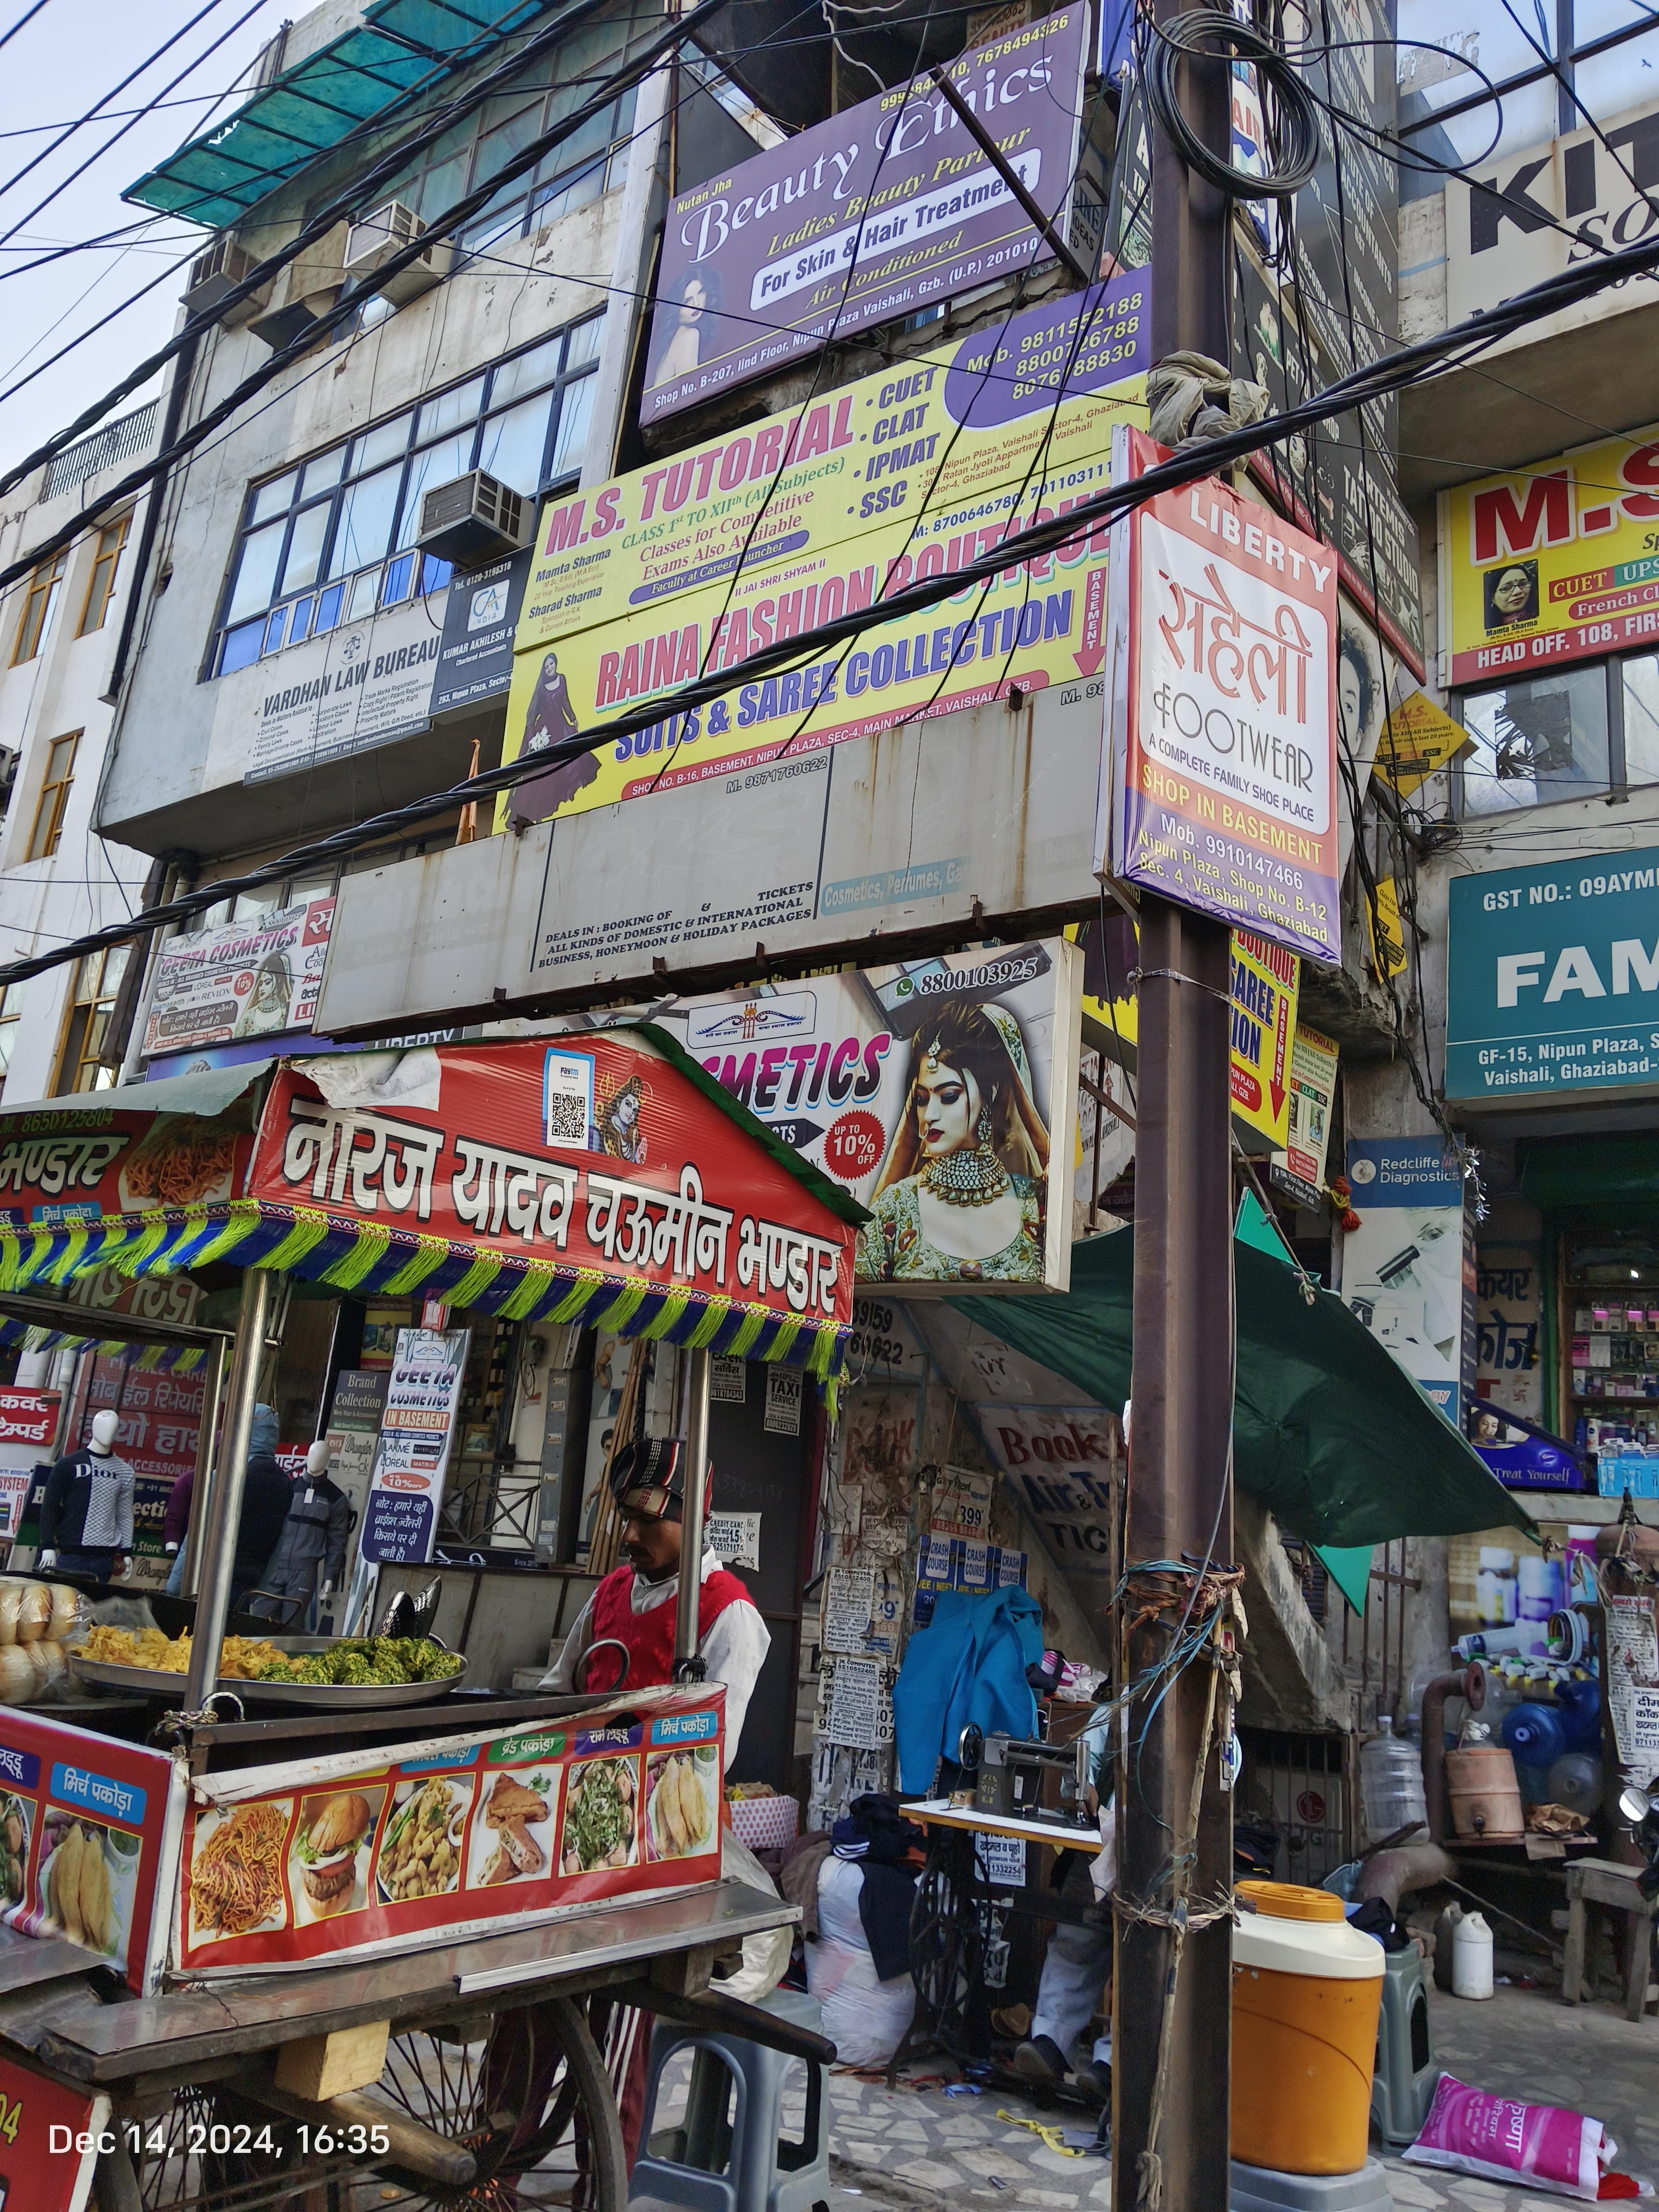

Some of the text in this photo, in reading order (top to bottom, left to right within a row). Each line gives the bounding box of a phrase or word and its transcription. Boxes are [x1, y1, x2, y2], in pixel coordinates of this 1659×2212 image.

[680, 55, 1053, 263] Beauty Ethics
[676, 179, 732, 214] Nutan Jha
[766, 171, 926, 257] Ladies Beauty
[1341, 163, 1393, 294] ACCOUNTANTS
[760, 218, 907, 298] For Skin Hair
[805, 230, 963, 309] Air Conditioned
[1299, 238, 1326, 302] Become
[655, 237, 1038, 408] Shop B-207, Floor, Vaishali, Gzb. 201010
[879, 366, 938, 409] CUET
[873, 403, 930, 445] CLAT
[1055, 421, 1093, 441] Vaishali
[1002, 429, 1039, 449] Vaishali
[866, 433, 940, 481] IPMAT
[544, 395, 855, 556] M.S. TUTORIAL
[860, 481, 907, 518] SSC
[1358, 461, 1406, 547] ARTEMIS
[621, 524, 664, 550] CLASS
[639, 536, 692, 563] Classes
[1190, 490, 1332, 594] LIBERTY
[535, 548, 612, 583] Mamta Sharma
[641, 543, 725, 581] Exams Also
[783, 563, 816, 583] SHYAM
[1384, 527, 1419, 600] STUDIO
[455, 581, 465, 591] Tel.
[650, 558, 734, 596] Faculty Career
[1553, 572, 1607, 598] CUET
[529, 585, 603, 620] Sharad Sharma
[1578, 592, 1638, 617] French
[473, 613, 496, 626] INDIA
[1486, 620, 1538, 637] Mamta Sharma
[443, 630, 505, 661] KUMAR AKHILESH
[595, 565, 876, 709] RAINA FASHION
[1158, 563, 1313, 725] सहेली
[1478, 642, 1526, 669] HEAD
[1532, 633, 1569, 656] OFF.
[1577, 623, 1619, 646] 108,
[456, 644, 507, 667] Chartered Accountants
[707, 589, 1073, 735] & SAREE COLLECTION
[263, 674, 332, 718] VARDHAN
[334, 661, 372, 693] LAW
[373, 635, 441, 679] BUREAU
[438, 682, 487, 705] 203, Nipun Plaza,
[1399, 705, 1428, 720] M.S.
[1154, 682, 1313, 793] FOOTWEAR
[1423, 724, 1451, 733] Subjects)
[676, 737, 825, 785] B-16, BASEMENT, PLAZA,
[1159, 738, 1314, 822] COMPLETE FAMILY SHOE PLACE
[1142, 763, 1323, 865] SHOP IN BASEMENT
[1160, 813, 1304, 890] Mob. 9910147466
[1138, 828, 1328, 921] Nipun Plaza, Shop No. B-12
[1192, 874, 1328, 943] Vaishali, Ghaziabad
[1483, 883, 1572, 912] GST NO.:
[545, 881, 814, 944] DEALS BOOKING TICKETS
[537, 908, 812, 969] BUSINESS, HONEYMOON HOLIDAY PACKAGES
[547, 897, 804, 955] ALL KINDS DOMESTIC INTERNATIONAL
[161, 926, 297, 978] GEETA COSMETICS
[920, 957, 1038, 995] 8800103925
[201, 987, 231, 1001] REVLON
[1276, 997, 1288, 1087] BASEMENT
[1298, 1024, 1334, 1053] TUTORIAL
[1479, 1036, 1645, 1066] GF-15, Nipun Plaza,
[560, 1067, 578, 1076] paytm
[1484, 1066, 1555, 1087] Vaishali,
[1301, 1085, 1327, 1105] CLAT SSC
[834, 1124, 860, 1135] UP TO
[833, 1134, 876, 1156] 10%
[857, 1153, 875, 1165] OFF
[1380, 1157, 1440, 1170] Redcliffe
[1380, 1171, 1460, 1184] Diagnostics
[452, 1139, 842, 1313] यादव चऊमीन भण्डार
[348, 1374, 377, 1389] Brand
[395, 1363, 457, 1387] GEETA
[770, 1378, 799, 1398] TAXI
[336, 1393, 381, 1408] Collection
[390, 1390, 452, 1407] COSMETICS
[771, 1393, 796, 1406] SERVICE
[386, 1410, 397, 1425] IN
[398, 1411, 448, 1429] BASEMENT
[384, 1443, 410, 1453] LAKMÉ
[74, 1463, 119, 1479] Dior
[1493, 1467, 1570, 1484] Treat Yourself
[394, 1499, 412, 1512] हमारे
[374, 1527, 396, 1542] किराये
[408, 1532, 417, 1547] दी
[930, 1542, 950, 1556] CRASH
[378, 1545, 396, 1558] जाती
[927, 1557, 948, 1572] COURSE
[966, 1549, 986, 1561] CRASH
[1002, 1555, 1020, 1568] CRASH
[965, 1563, 985, 1577] COURSE
[1000, 1569, 1020, 1583] COURSE
[918, 1580, 931, 1590] JEE
[838, 1664, 876, 1675] 8510852400
[847, 1659, 876, 1670] COMPUTER
[661, 1718, 709, 1737] मिर्च पकोड़ा
[63, 1767, 132, 1817] मिर्च पकोड़ा
